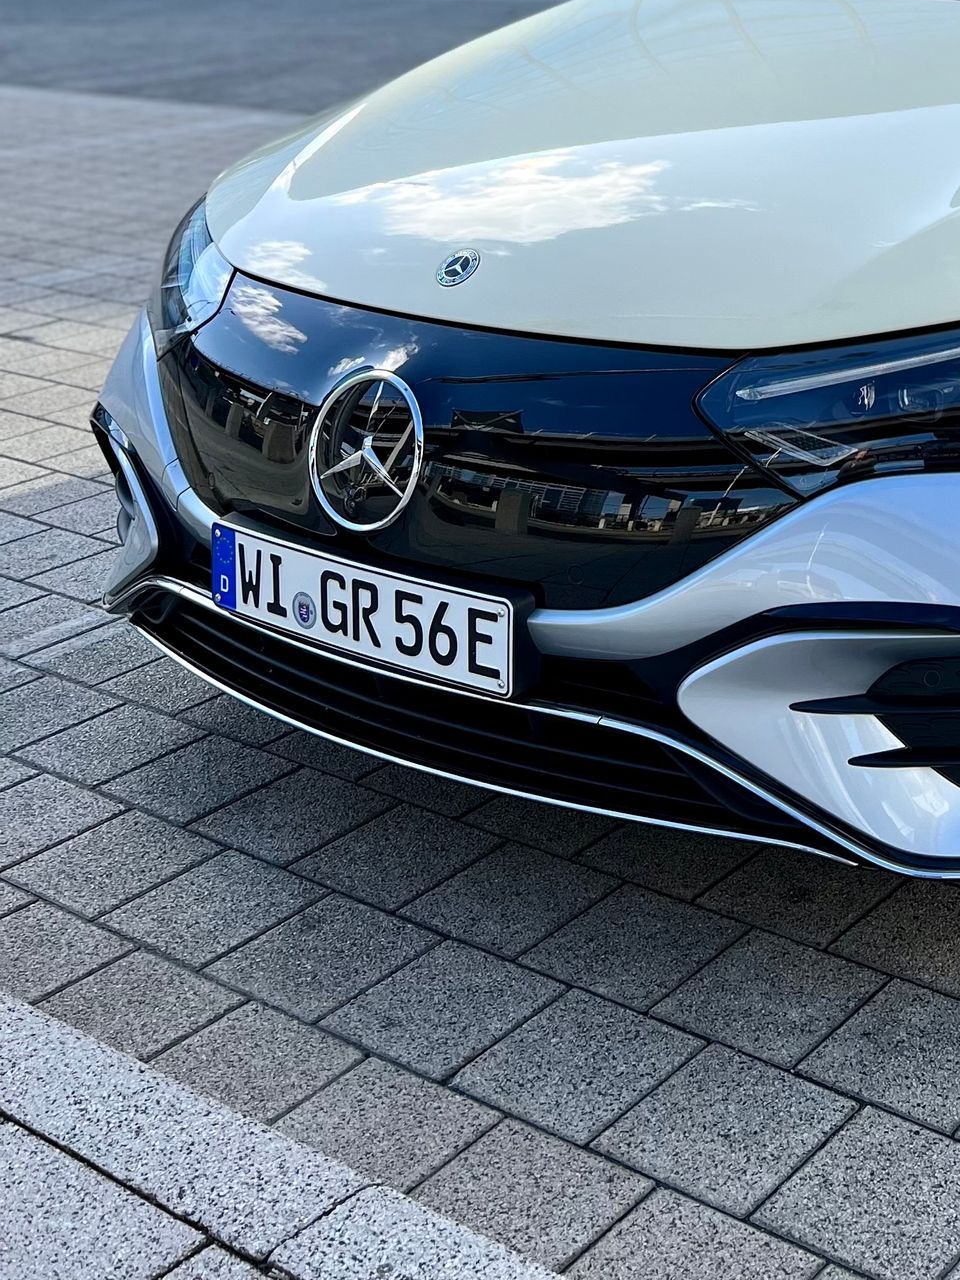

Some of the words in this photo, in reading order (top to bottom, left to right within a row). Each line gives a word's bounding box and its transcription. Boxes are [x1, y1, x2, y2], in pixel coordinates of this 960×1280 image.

[220, 574, 229, 593] D
[238, 542, 288, 618] WI
[320, 569, 381, 648] GR
[394, 589, 501, 680] 56E
